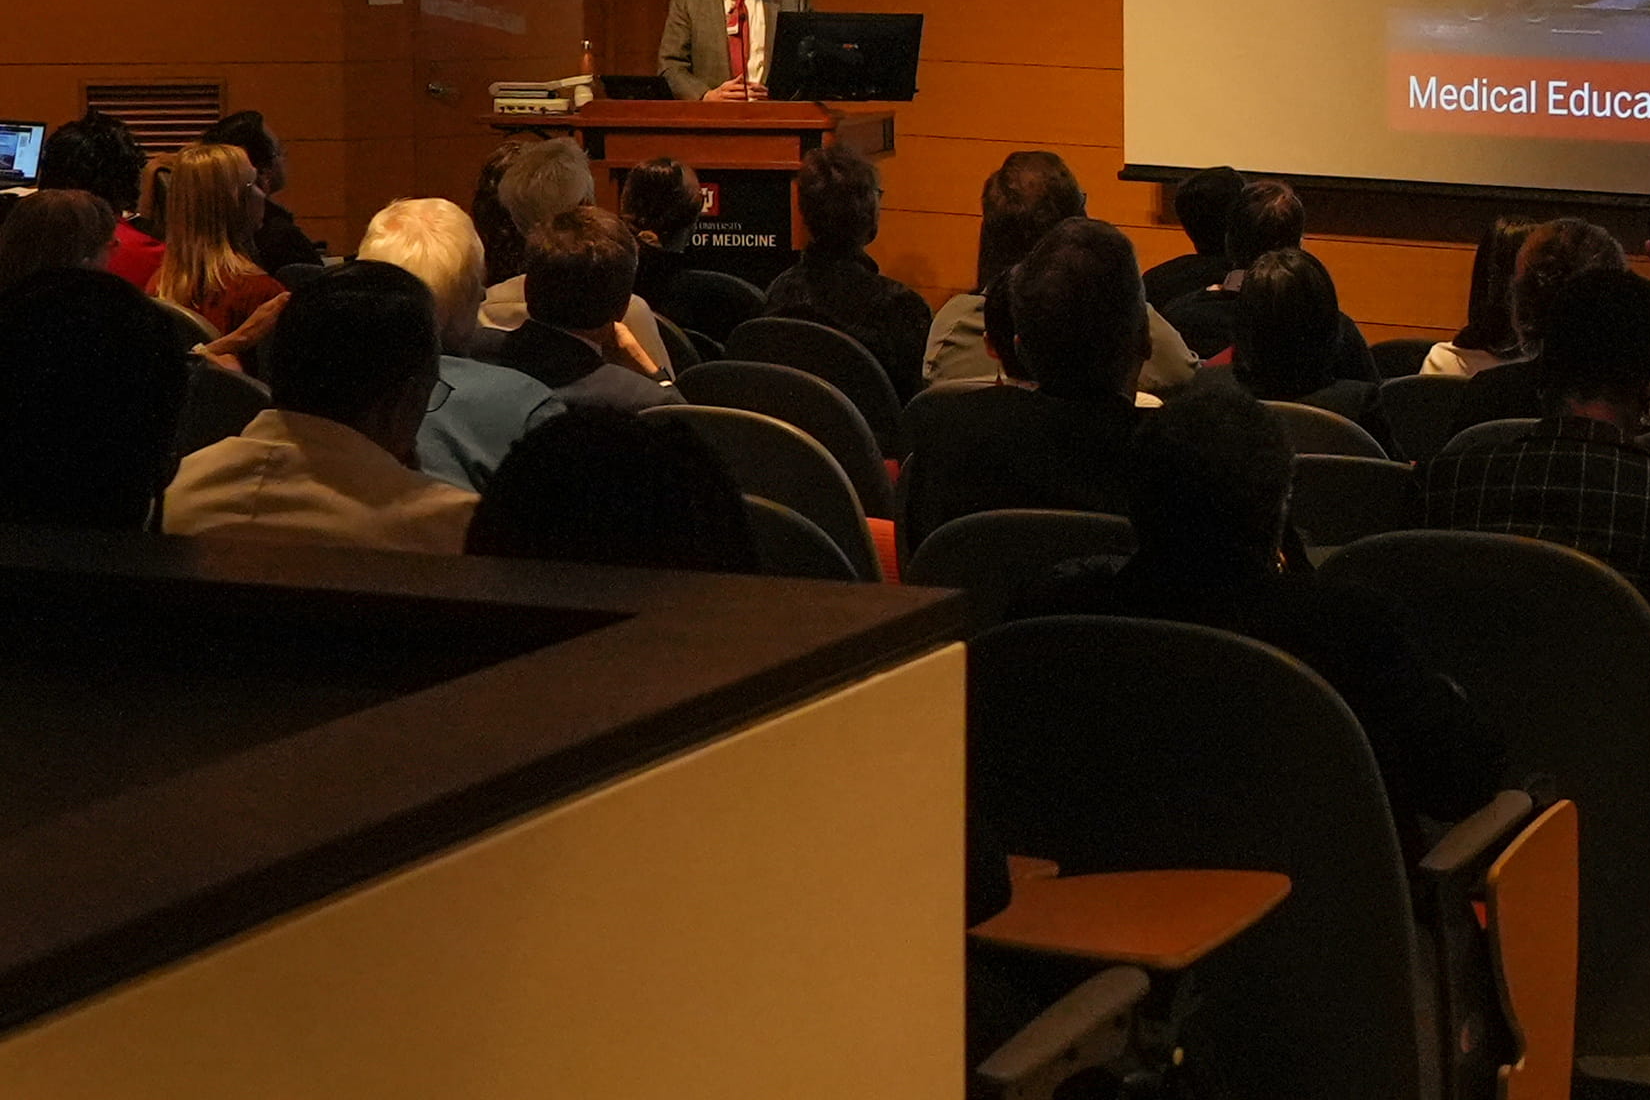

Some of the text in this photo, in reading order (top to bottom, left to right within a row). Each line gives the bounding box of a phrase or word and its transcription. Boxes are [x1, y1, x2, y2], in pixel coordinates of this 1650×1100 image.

[1408, 75, 1537, 114] Medical
[691, 233, 777, 248] OF MEDICINE
